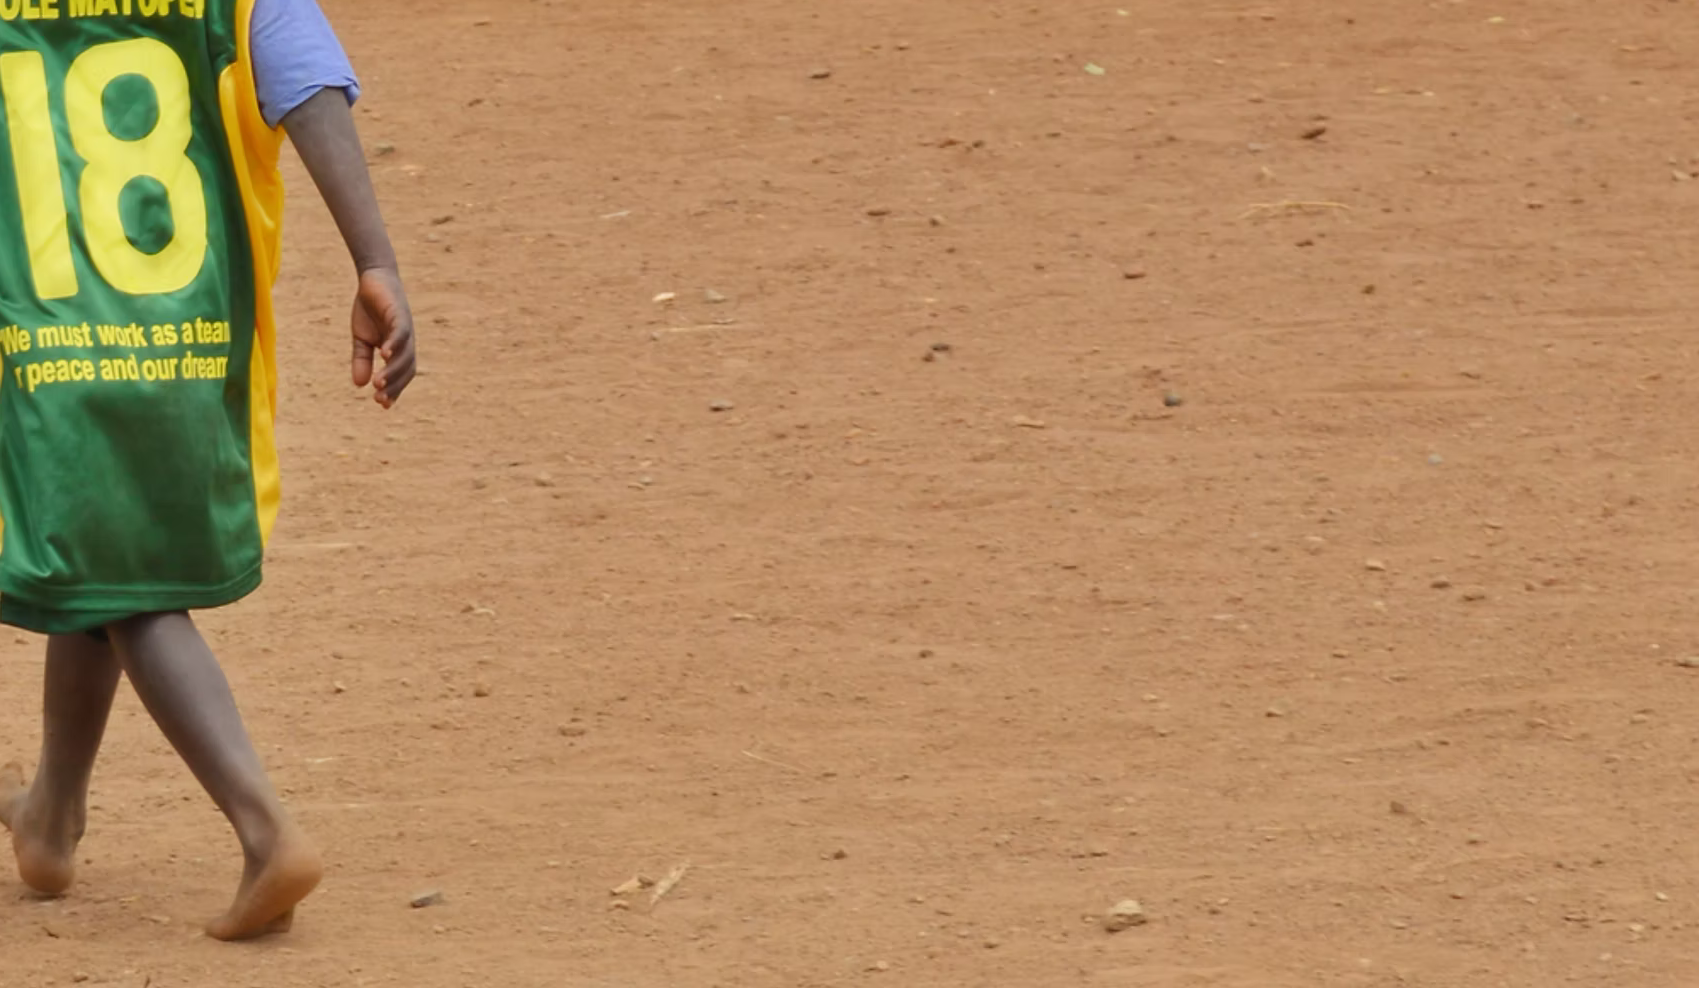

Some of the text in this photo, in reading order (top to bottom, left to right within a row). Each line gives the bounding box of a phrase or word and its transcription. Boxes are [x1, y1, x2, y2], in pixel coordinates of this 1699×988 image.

[37, 321, 94, 349] must
[97, 322, 148, 348] work
[151, 323, 179, 346] as
[182, 321, 194, 344] a
[26, 358, 96, 393] peace
[100, 353, 139, 382] and
[142, 357, 178, 381] our
